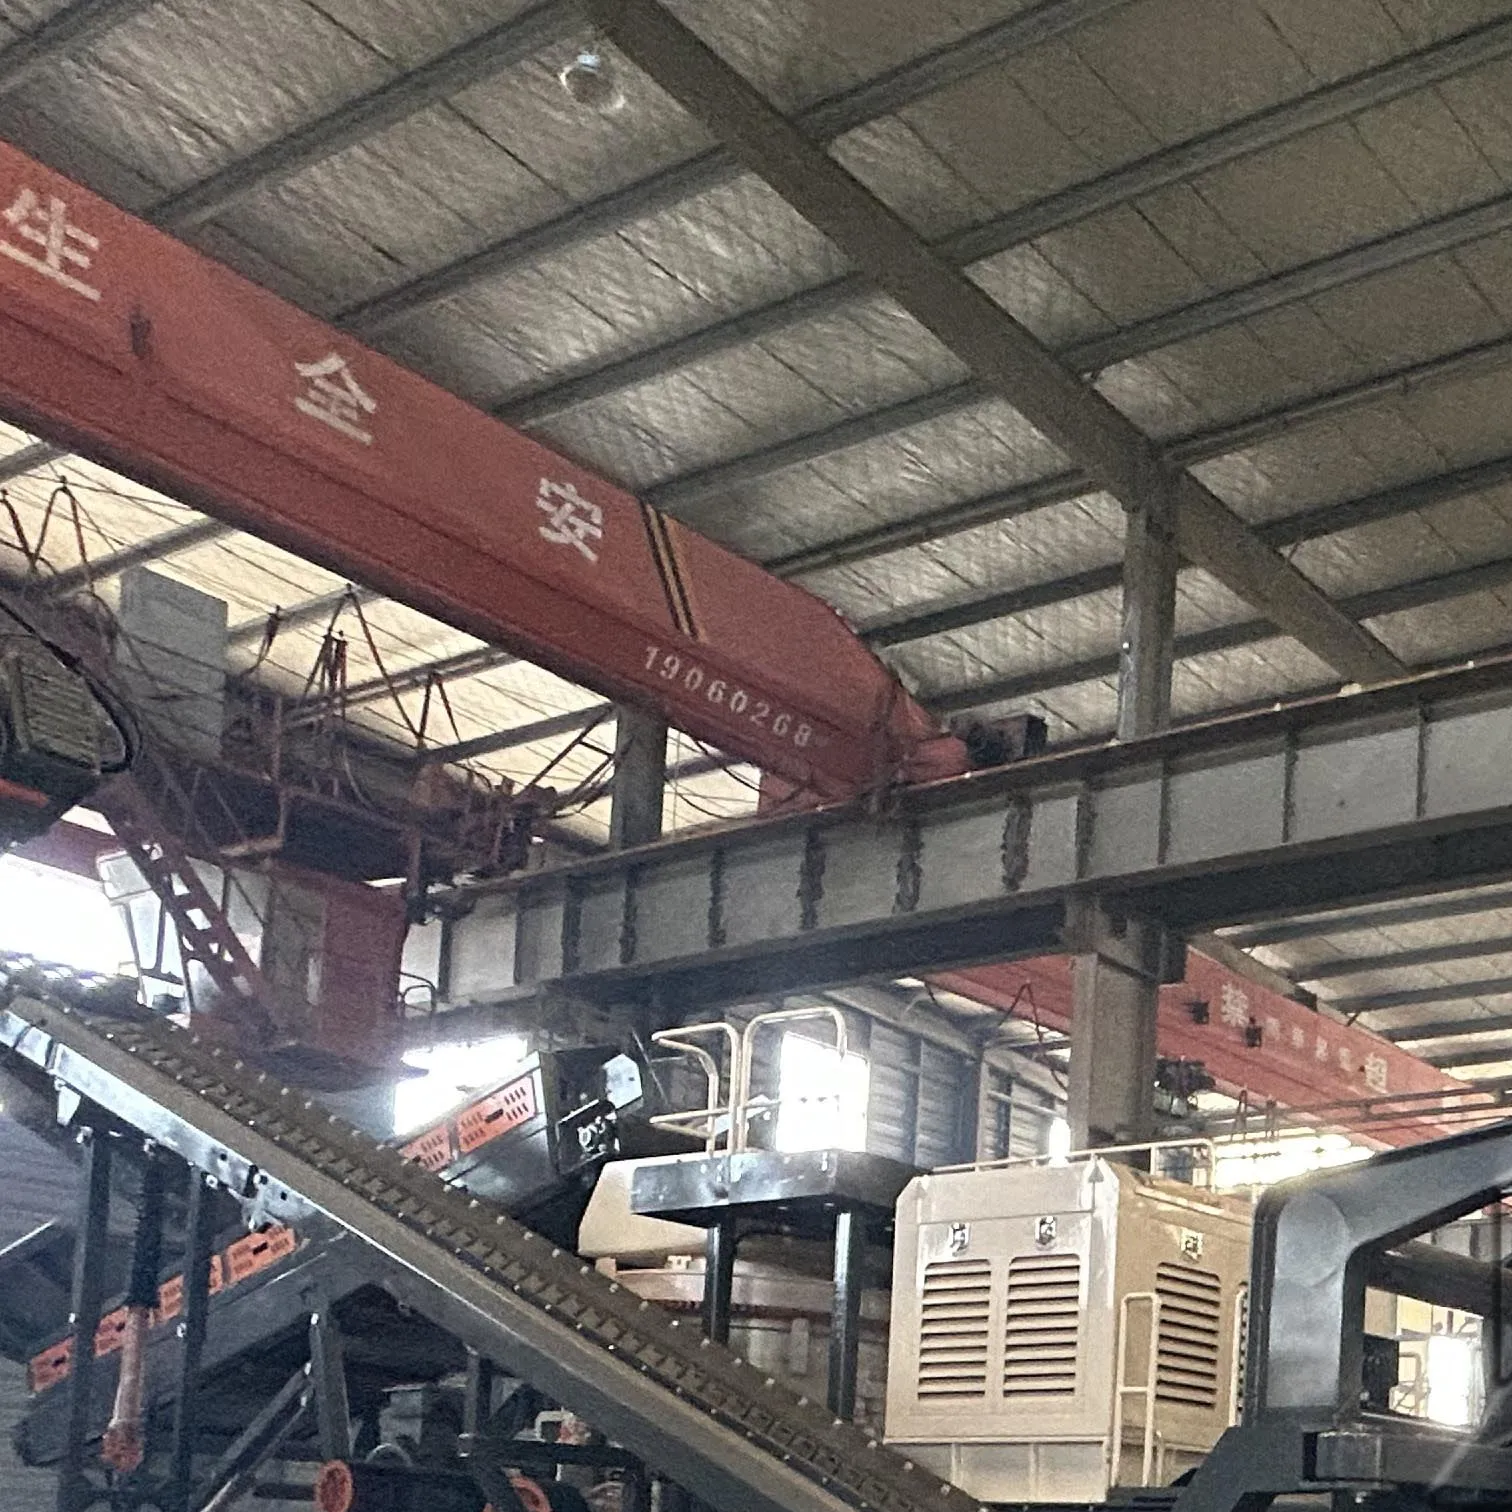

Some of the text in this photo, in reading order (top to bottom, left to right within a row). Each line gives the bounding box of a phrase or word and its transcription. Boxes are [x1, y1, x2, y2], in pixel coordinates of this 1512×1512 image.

[0, 188, 603, 562] 生 全 安
[645, 646, 813, 747] 19060268
